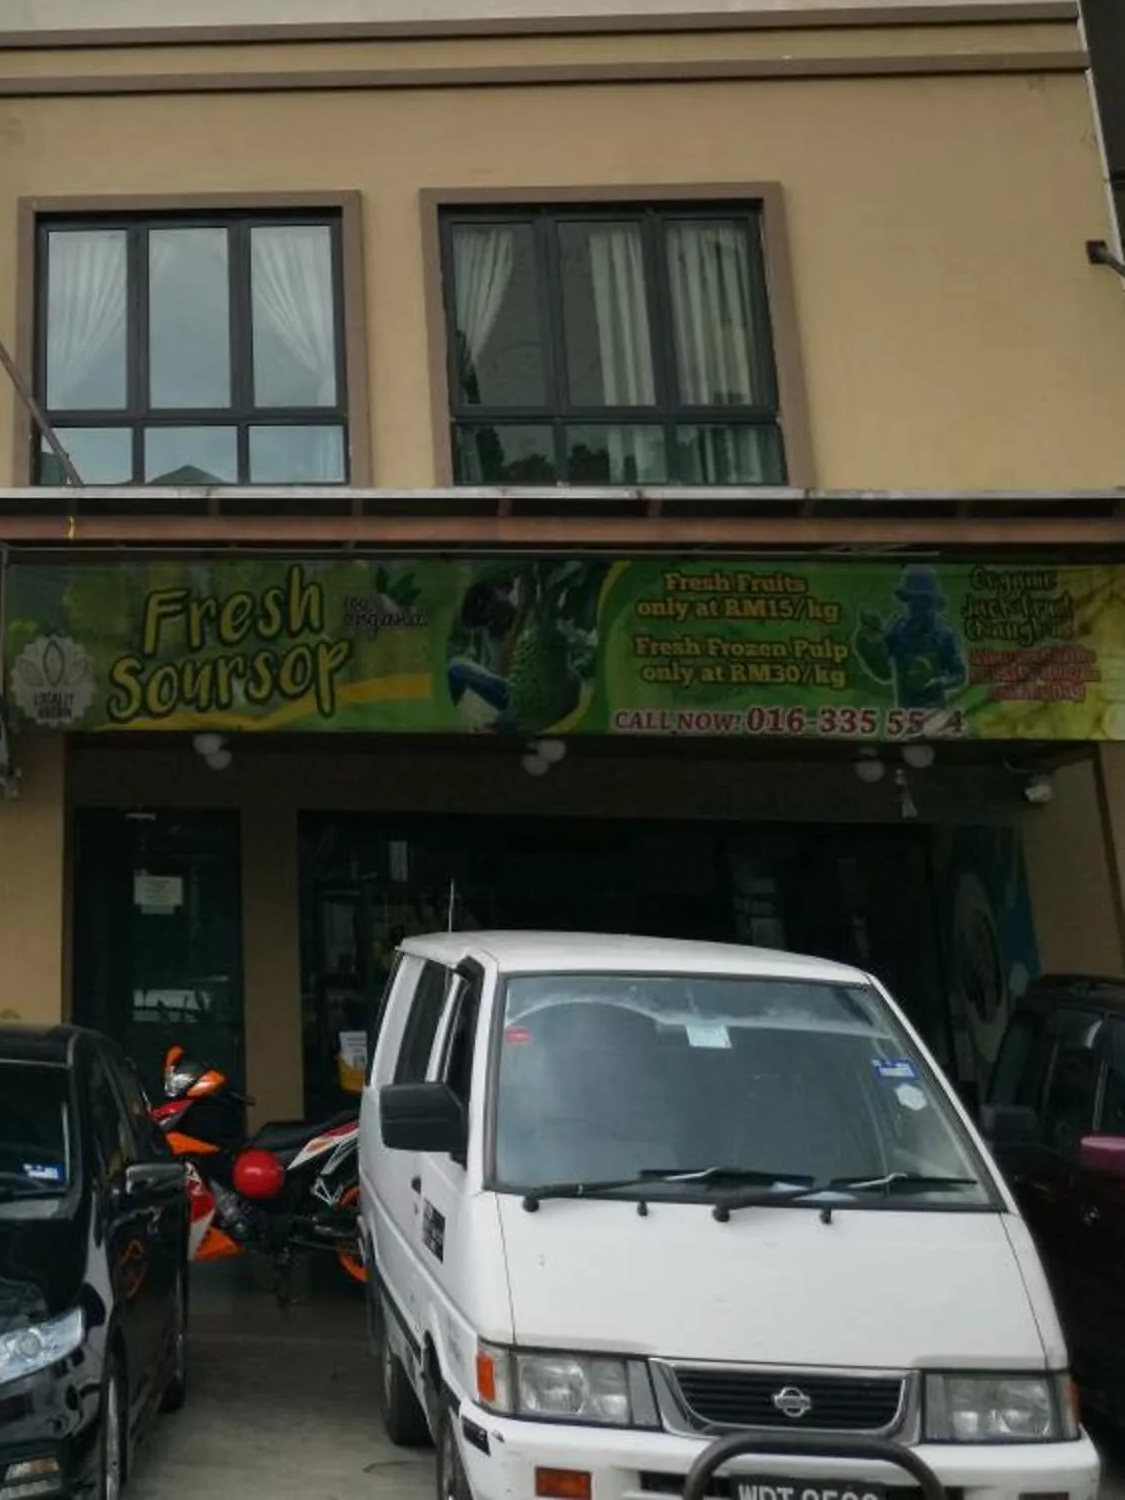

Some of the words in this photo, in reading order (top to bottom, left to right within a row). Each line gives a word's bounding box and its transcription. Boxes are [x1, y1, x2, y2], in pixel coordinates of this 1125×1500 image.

[664, 571, 731, 592] Fresh
[737, 571, 807, 592] Fruits
[143, 563, 324, 655] Fresh
[637, 599, 689, 621] only
[696, 600, 718, 617] at
[635, 636, 701, 656] Fresh
[707, 637, 788, 658] Frozen
[792, 638, 849, 664] Pulp
[108, 640, 352, 719] Soursop
[641, 662, 695, 687] only
[701, 665, 724, 682] at
[615, 711, 670, 731] CALL
